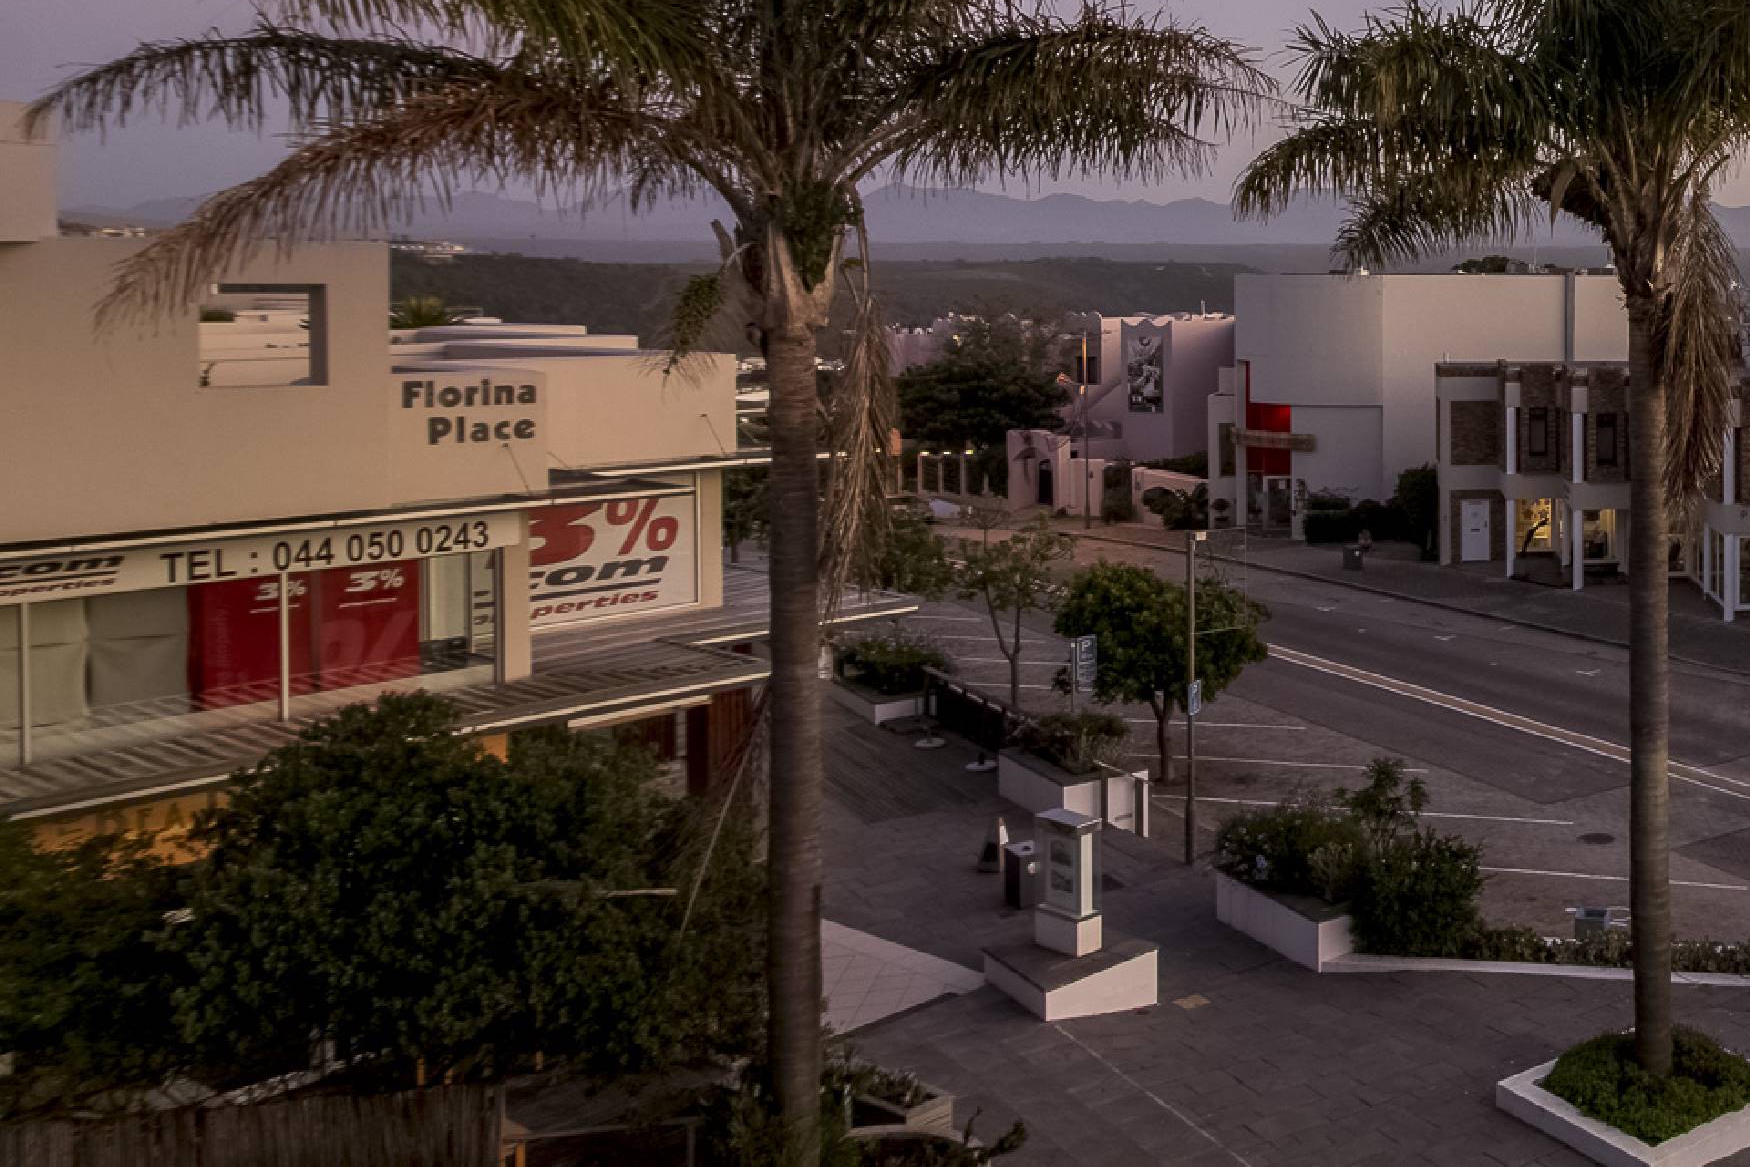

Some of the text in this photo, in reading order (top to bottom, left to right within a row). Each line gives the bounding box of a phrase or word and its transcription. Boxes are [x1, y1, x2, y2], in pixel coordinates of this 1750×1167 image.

[401, 379, 537, 408] Florina
[428, 417, 536, 445] Place
[160, 549, 236, 584] TEL
[273, 539, 335, 572] 044
[347, 530, 402, 562] 050
[417, 521, 488, 554] 0243
